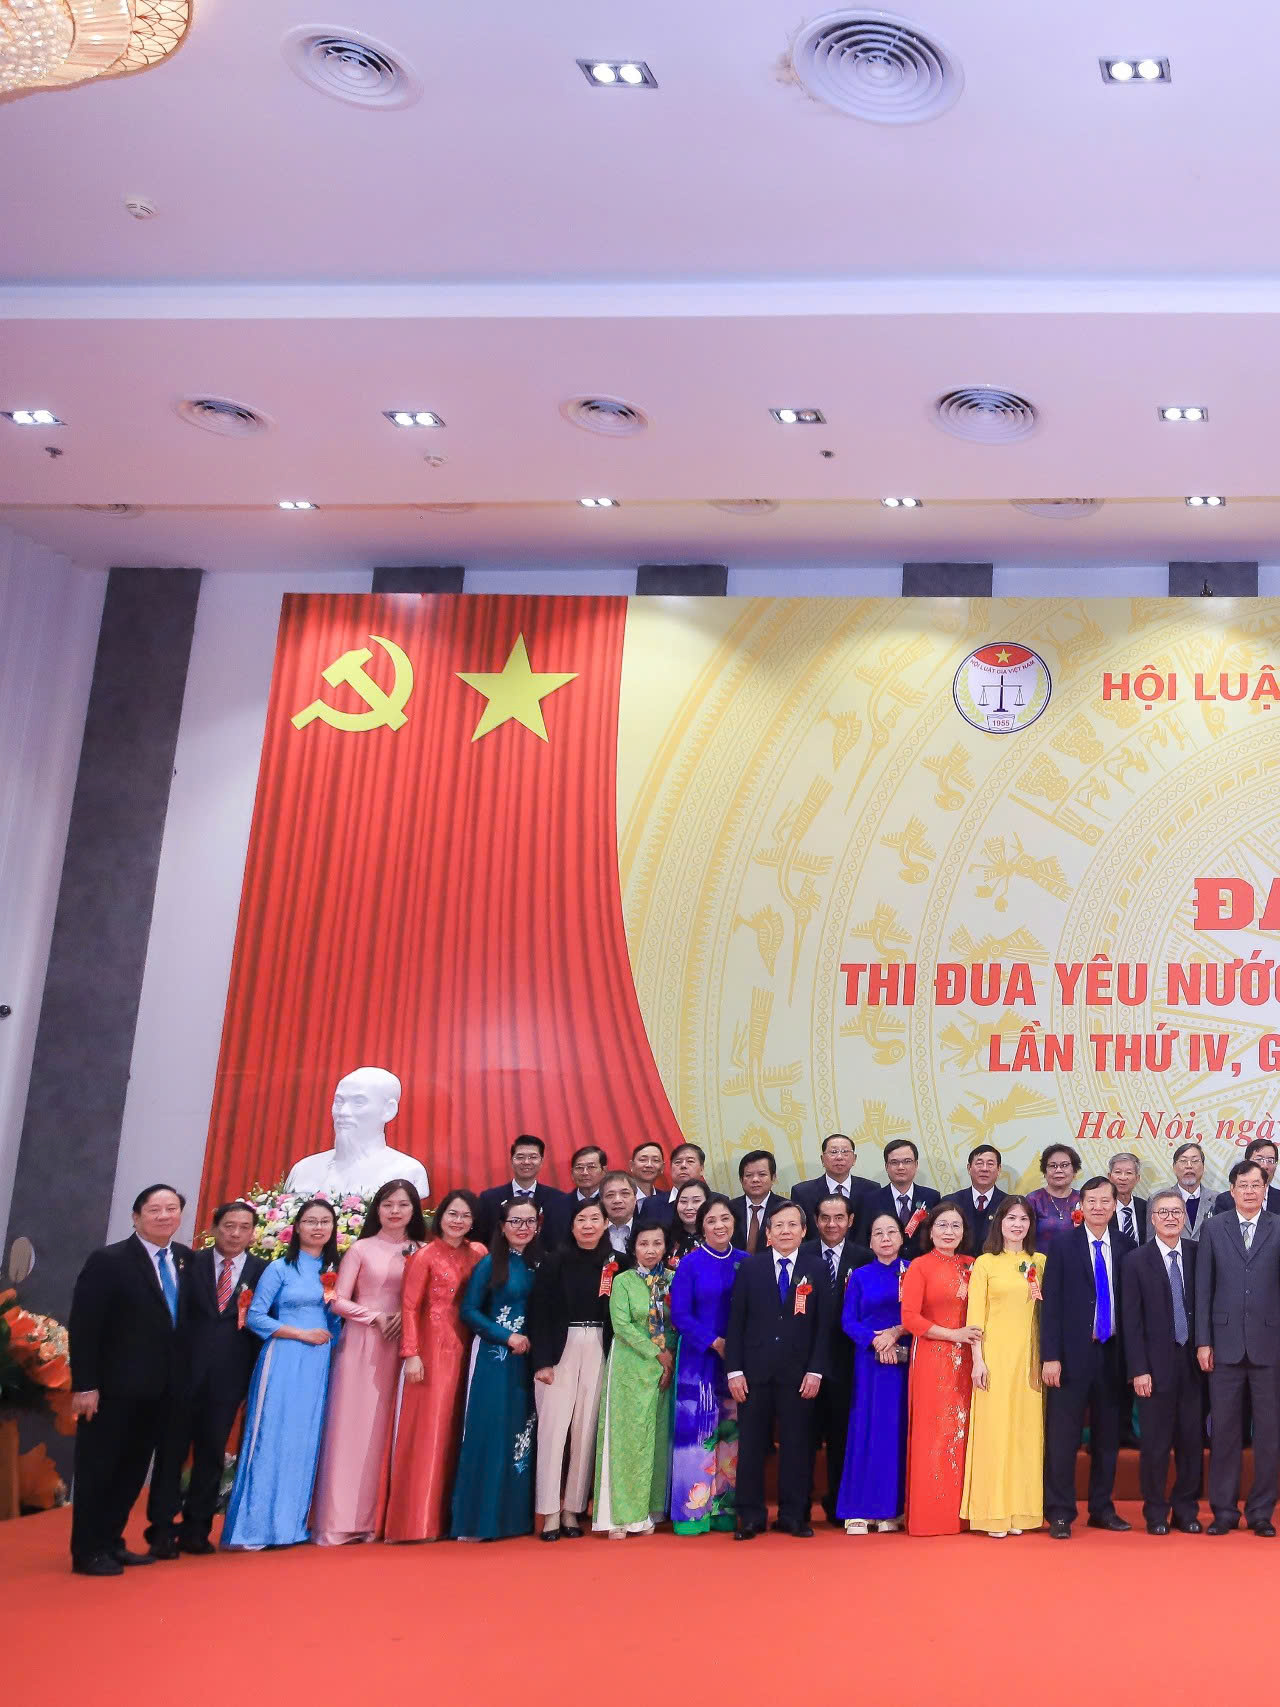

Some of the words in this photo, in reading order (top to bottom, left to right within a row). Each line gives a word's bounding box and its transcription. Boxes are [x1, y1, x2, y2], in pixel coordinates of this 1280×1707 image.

[1103, 664, 1177, 710] HỘI
[839, 962, 917, 1007] THI
[933, 962, 1039, 1007] ĐUA
[1054, 953, 1149, 1007] YÊU
[988, 1020, 1075, 1073] LẦN
[1089, 1022, 1180, 1073] THỨ
[1189, 1033, 1242, 1077] IV,
[1074, 1111, 1126, 1139] Hà
[1135, 1111, 1203, 1147] Nội,
